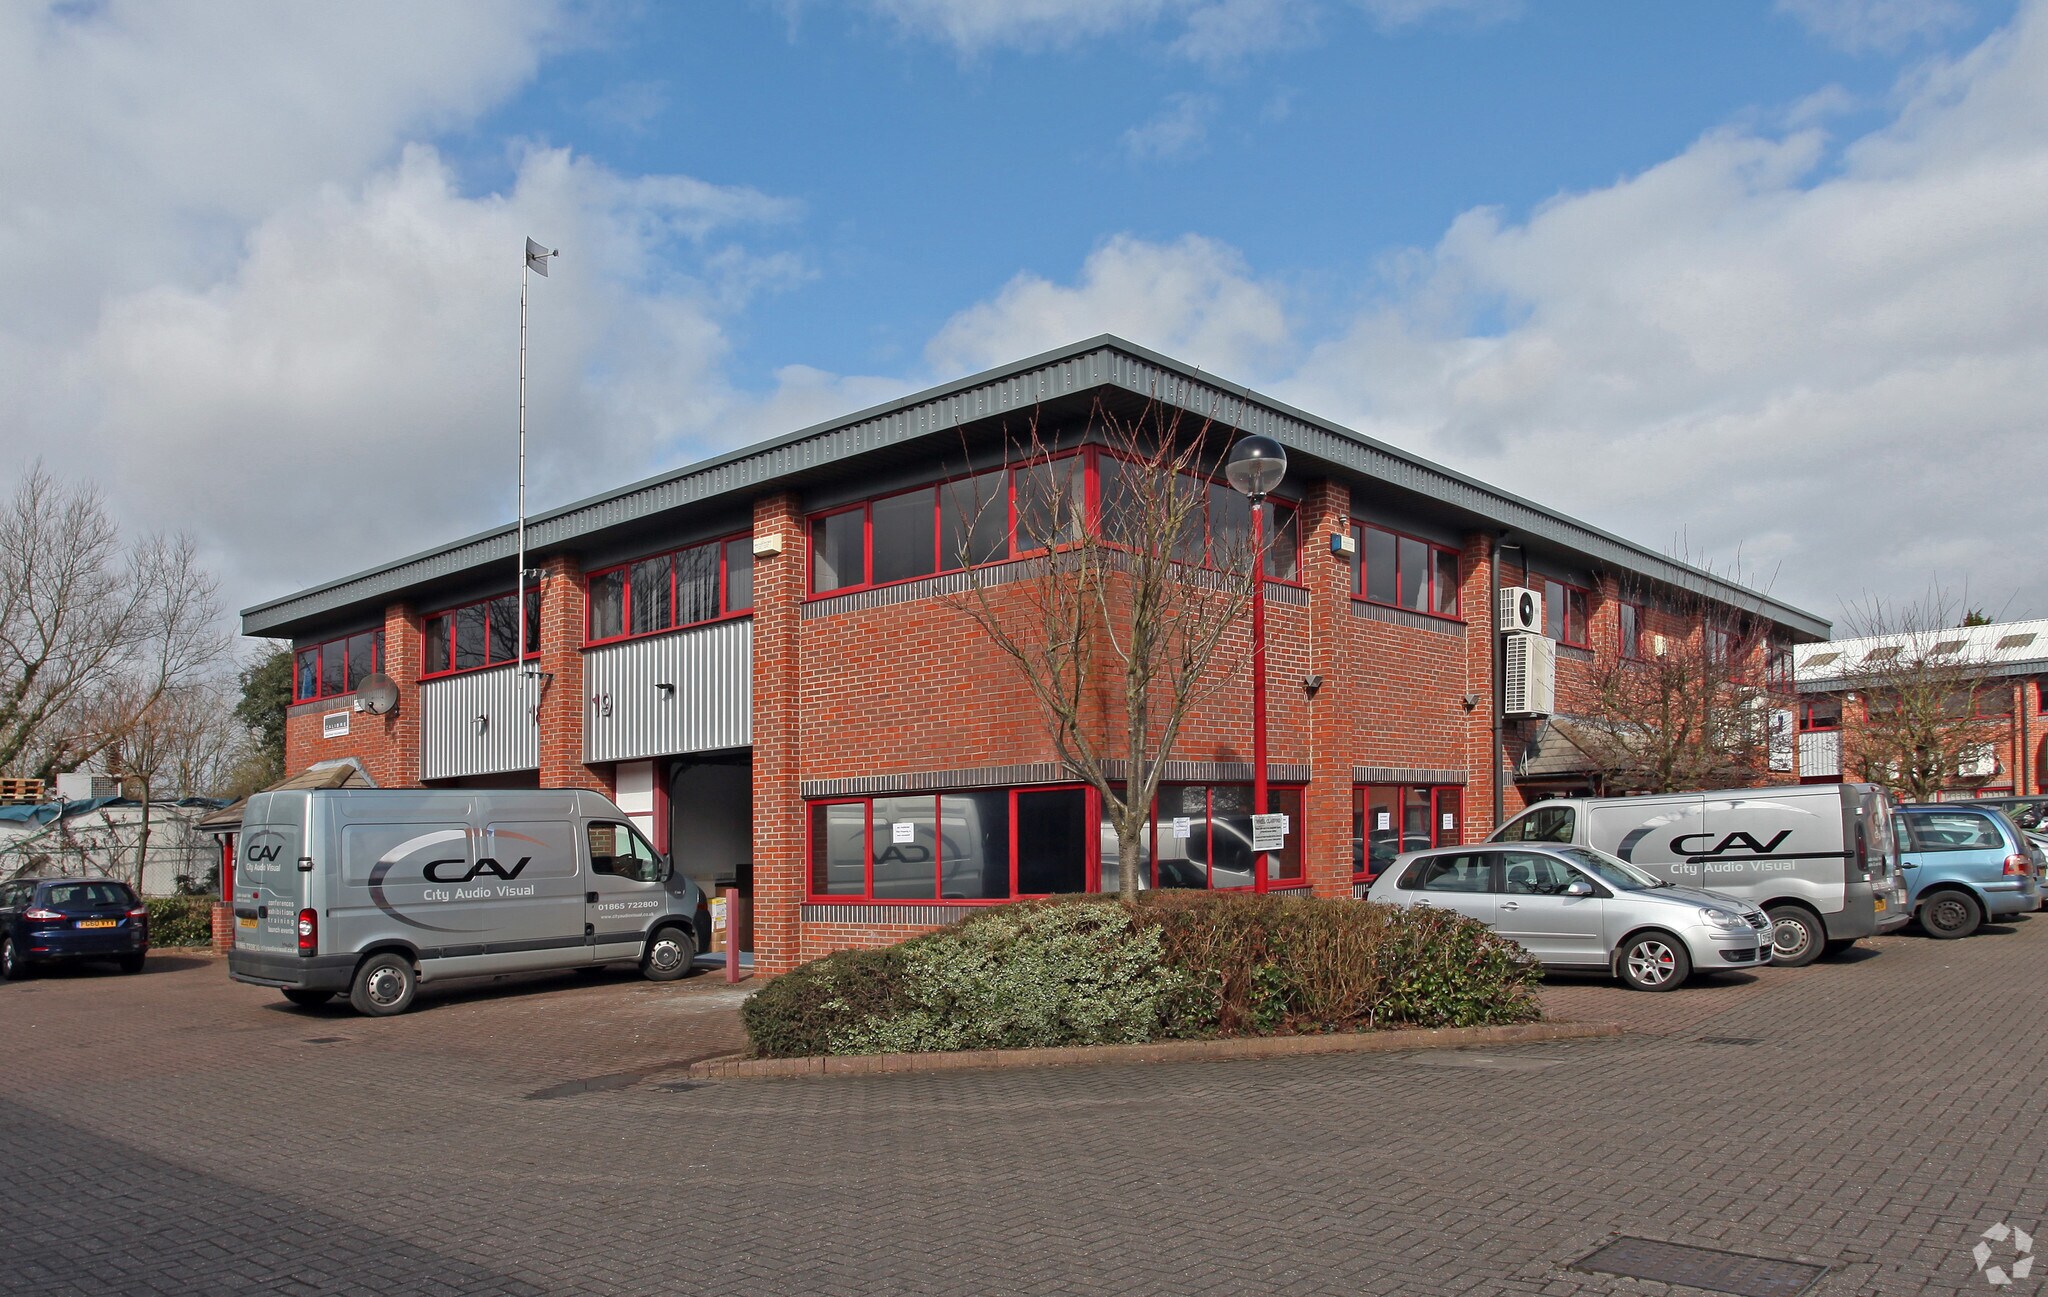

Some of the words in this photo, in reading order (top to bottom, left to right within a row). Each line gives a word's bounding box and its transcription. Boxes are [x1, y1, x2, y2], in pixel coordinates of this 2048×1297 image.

[592, 693, 613, 718] 19
[1669, 829, 1794, 856] CAV
[247, 845, 282, 862] CAV
[266, 863, 281, 872] Visual
[422, 856, 532, 884] CAV
[1670, 862, 1697, 876] City
[1704, 861, 1744, 873] Audio
[1750, 859, 1796, 872] Visual
[423, 889, 449, 902] City
[455, 886, 491, 899] Audio
[496, 884, 534, 897] Visual
[268, 899, 294, 908] conferences
[268, 908, 294, 916] exhibitions
[598, 902, 625, 911] 01865
[627, 900, 659, 909] 722800
[267, 916, 295, 927] training
